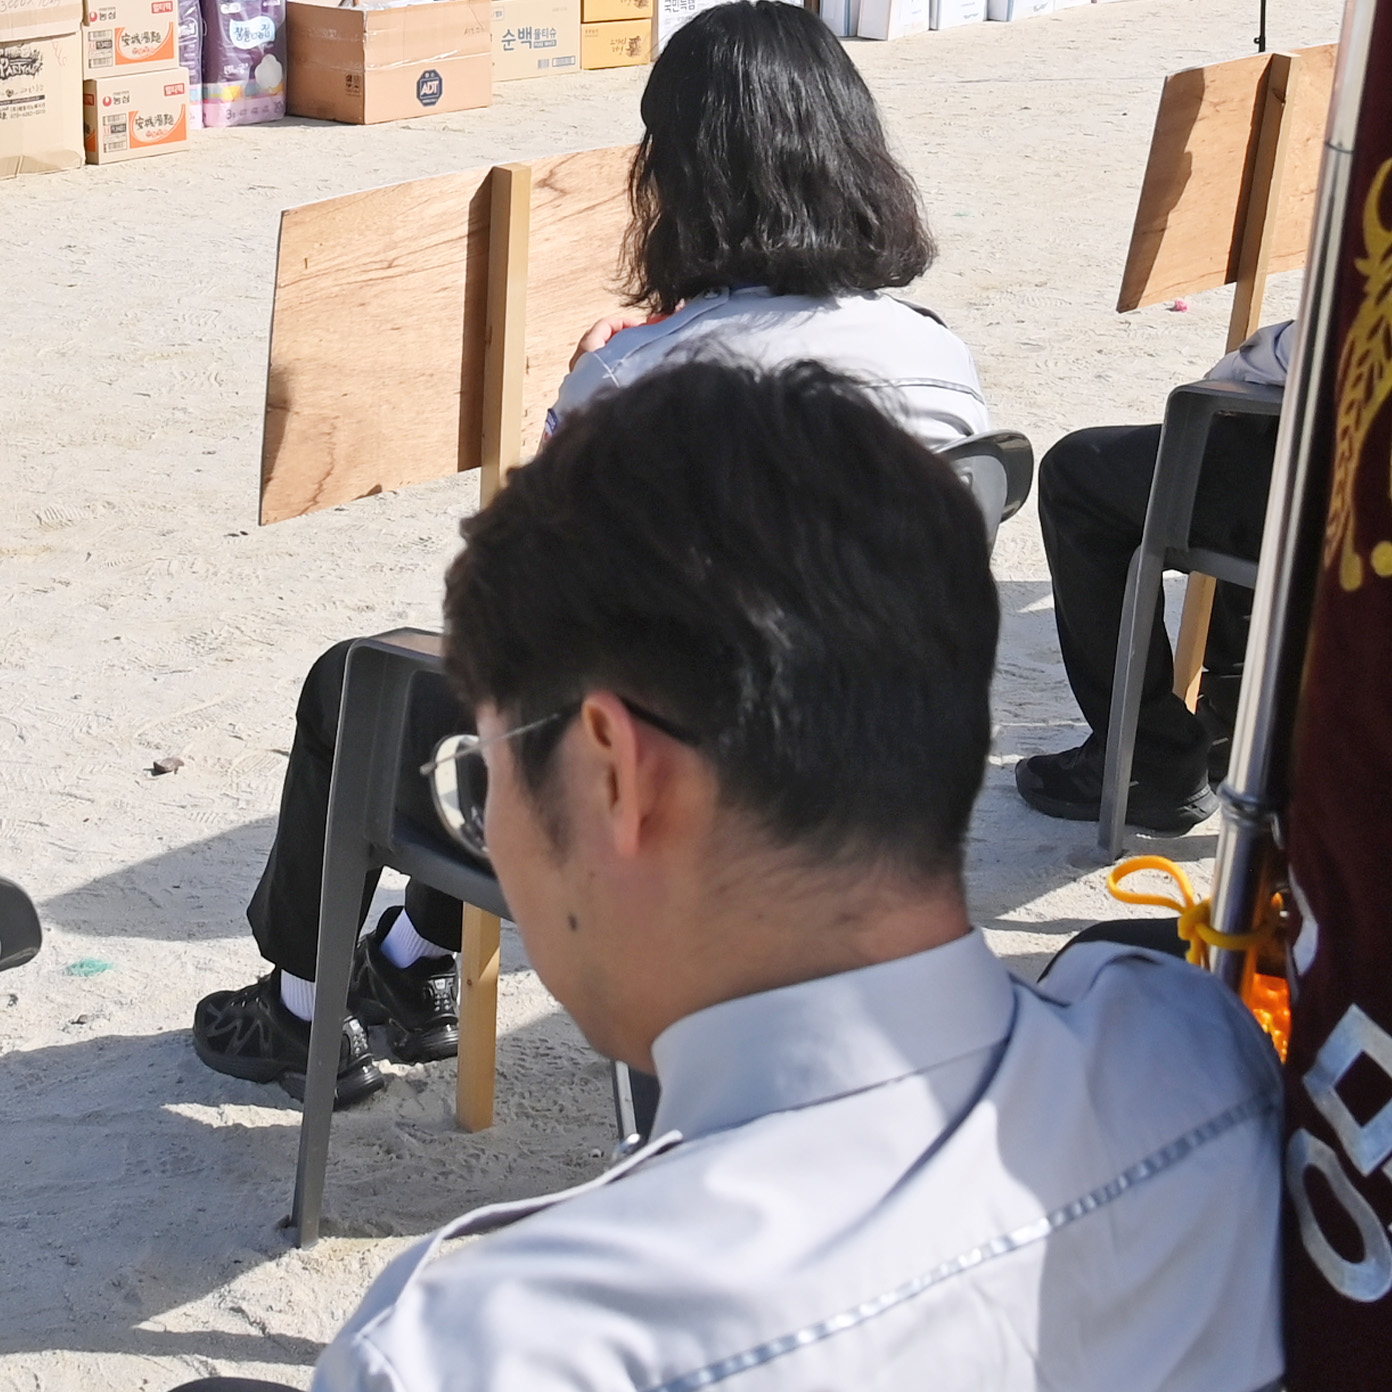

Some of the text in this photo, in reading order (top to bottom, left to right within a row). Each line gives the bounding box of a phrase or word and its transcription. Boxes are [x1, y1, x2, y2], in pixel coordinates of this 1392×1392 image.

[99, 11, 116, 21] 농심
[501, 26, 532, 52] 순백
[420, 81, 439, 95] ADT
[113, 95, 130, 105] 농심
